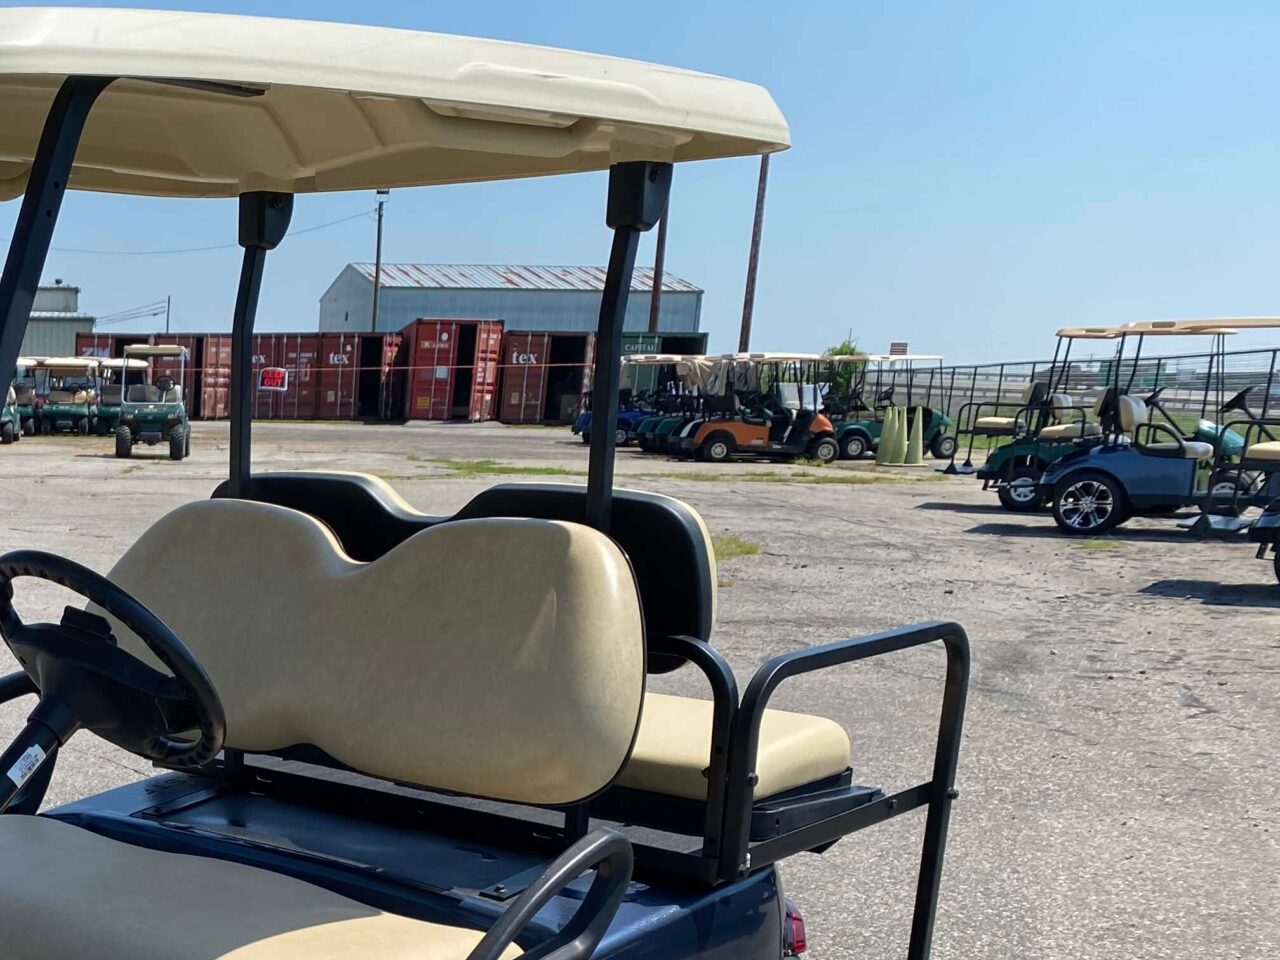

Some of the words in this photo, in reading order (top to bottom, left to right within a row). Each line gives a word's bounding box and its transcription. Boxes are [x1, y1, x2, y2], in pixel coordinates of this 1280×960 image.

[252, 353, 266, 363] ex
[329, 351, 350, 364] tex
[512, 351, 538, 364] tex
[263, 370, 284, 378] KEEP
[264, 378, 282, 387] OUT
